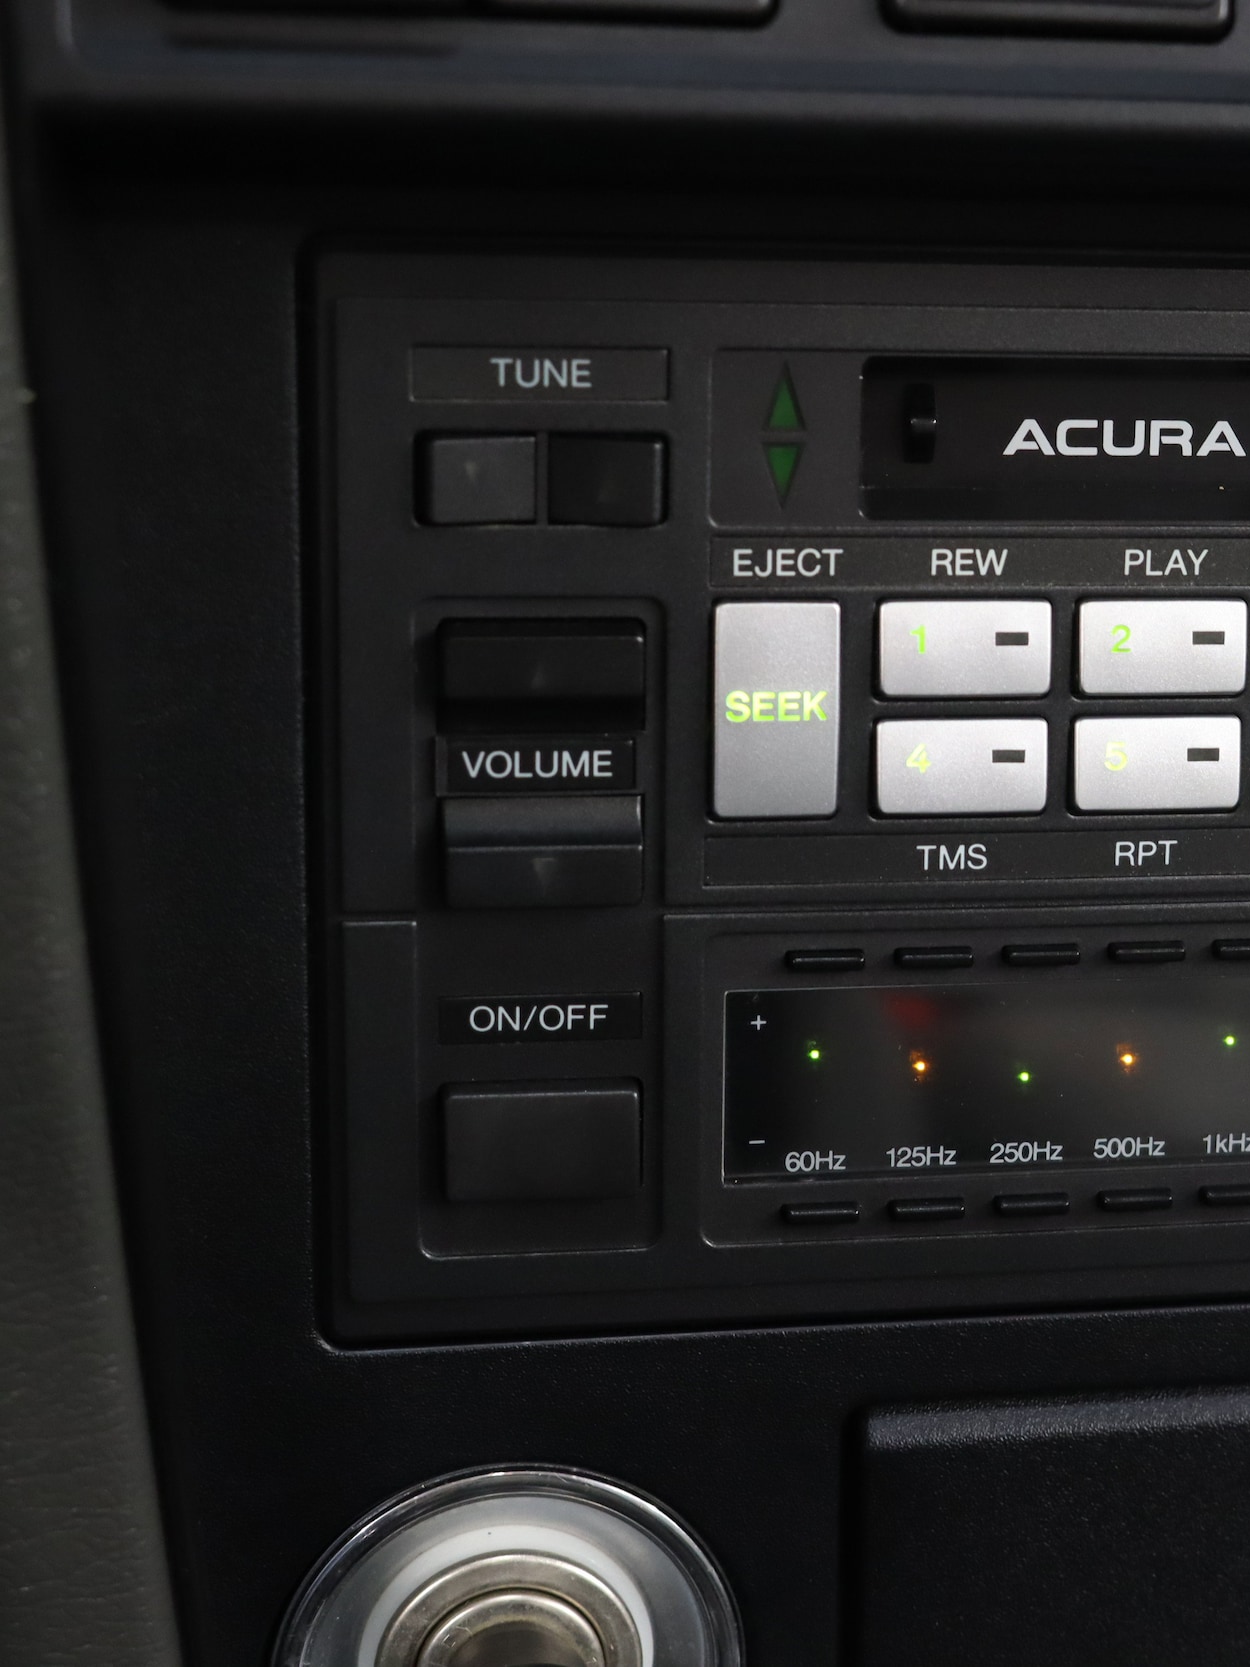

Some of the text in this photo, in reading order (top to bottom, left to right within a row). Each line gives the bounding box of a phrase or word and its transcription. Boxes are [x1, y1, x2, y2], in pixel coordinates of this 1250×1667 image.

[490, 357, 592, 389] TUNE
[1002, 418, 1247, 457] ACURA
[733, 547, 844, 578] EJECT
[931, 548, 1008, 576] REW
[1124, 548, 1209, 576] PLAY
[910, 624, 927, 655] 1
[1110, 624, 1132, 654] 2
[725, 691, 828, 723] SEEK
[462, 750, 613, 779] VOLUME
[905, 744, 931, 773] 4
[1104, 740, 1129, 772] 5
[916, 843, 988, 871] TMS
[1114, 840, 1178, 867] RPT
[469, 1004, 609, 1032] ON/OFF
[785, 1150, 847, 1173] 60Hz
[886, 1145, 957, 1168] 125Hz
[989, 1140, 1063, 1164] 250Hz
[1093, 1136, 1166, 1159] 500Hz
